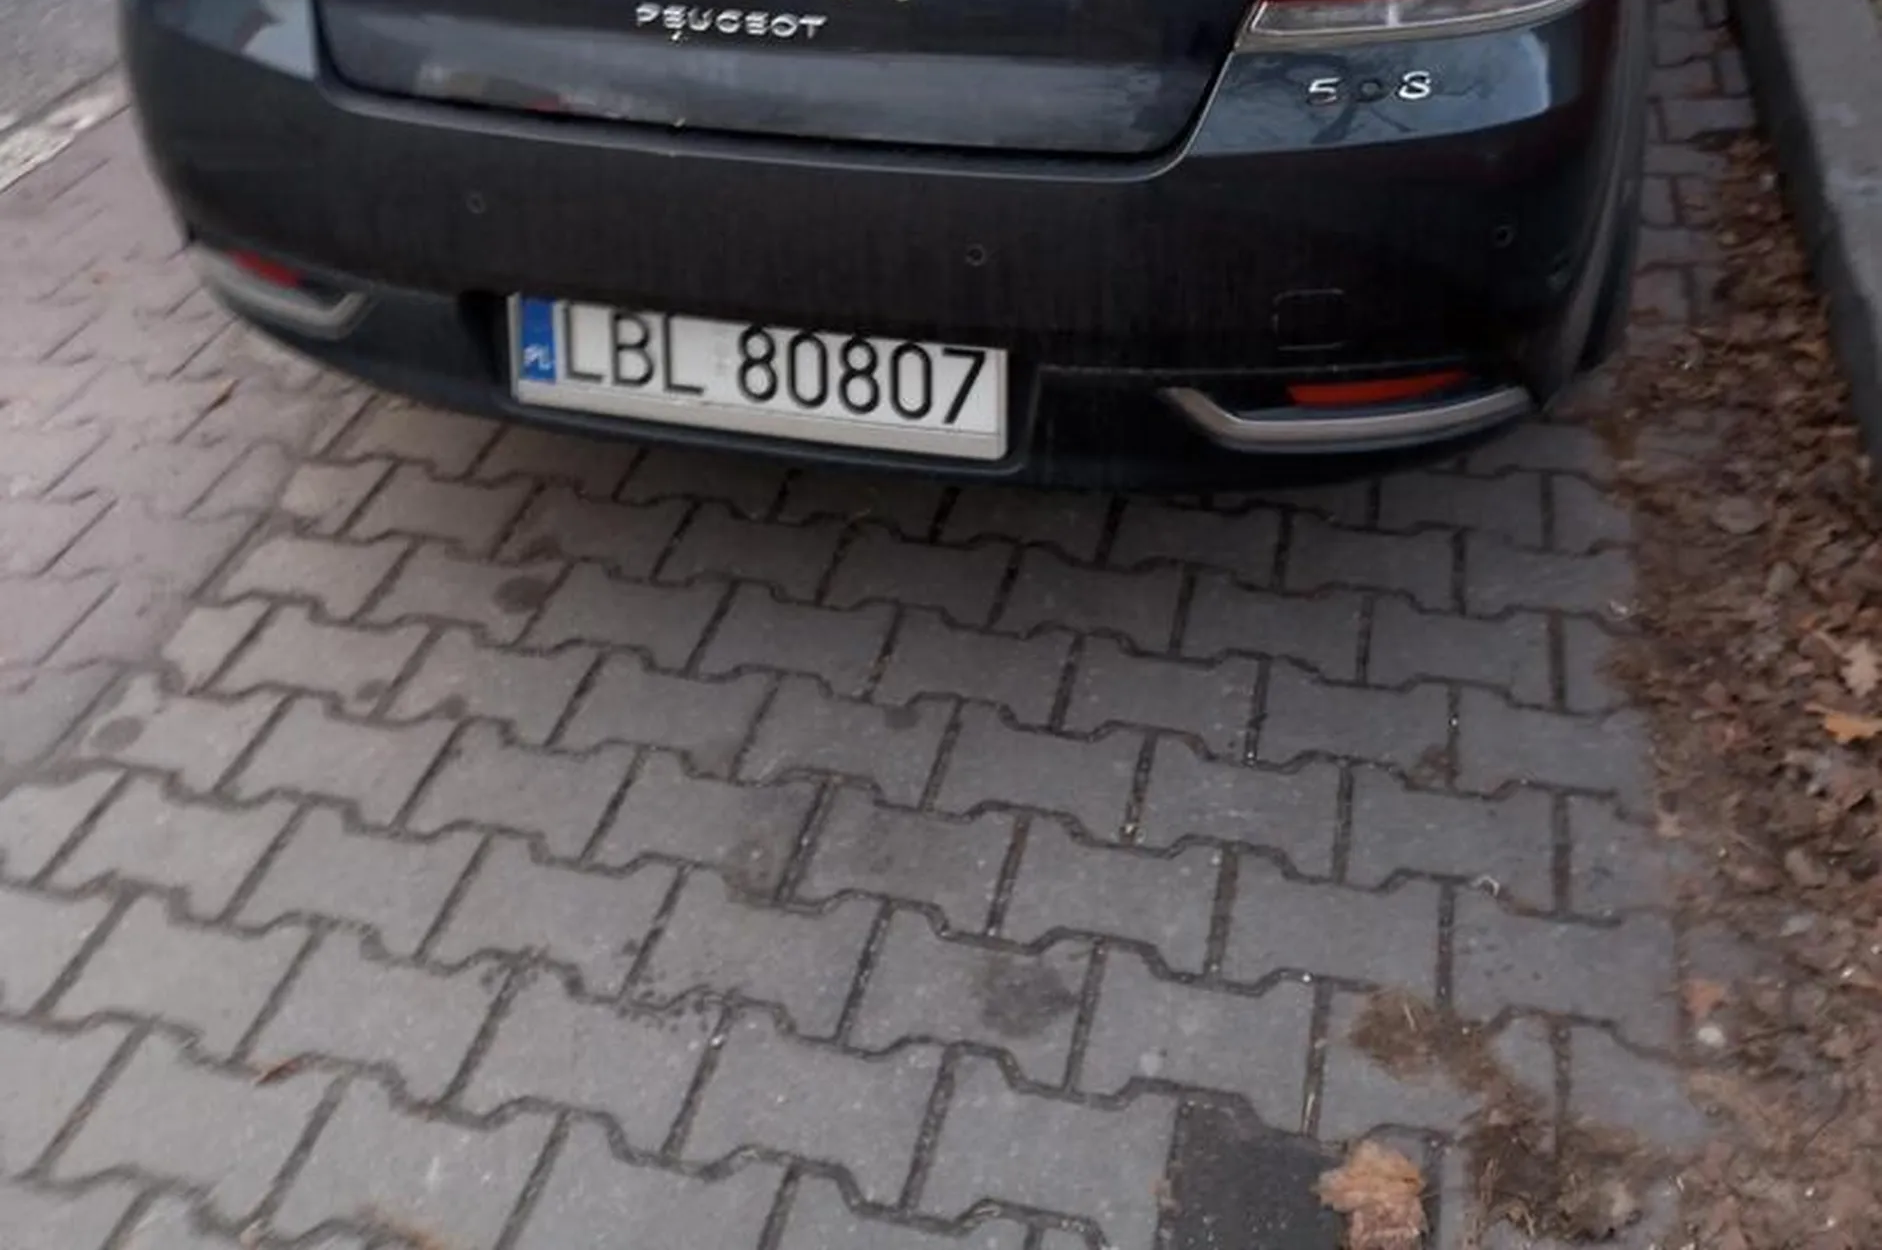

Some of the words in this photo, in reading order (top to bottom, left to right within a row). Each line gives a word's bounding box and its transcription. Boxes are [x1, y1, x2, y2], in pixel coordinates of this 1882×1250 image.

[636, 3, 827, 38] PEUGEOT
[1307, 70, 1431, 103] 508
[563, 302, 705, 394] LBL
[738, 324, 987, 425] 80807
